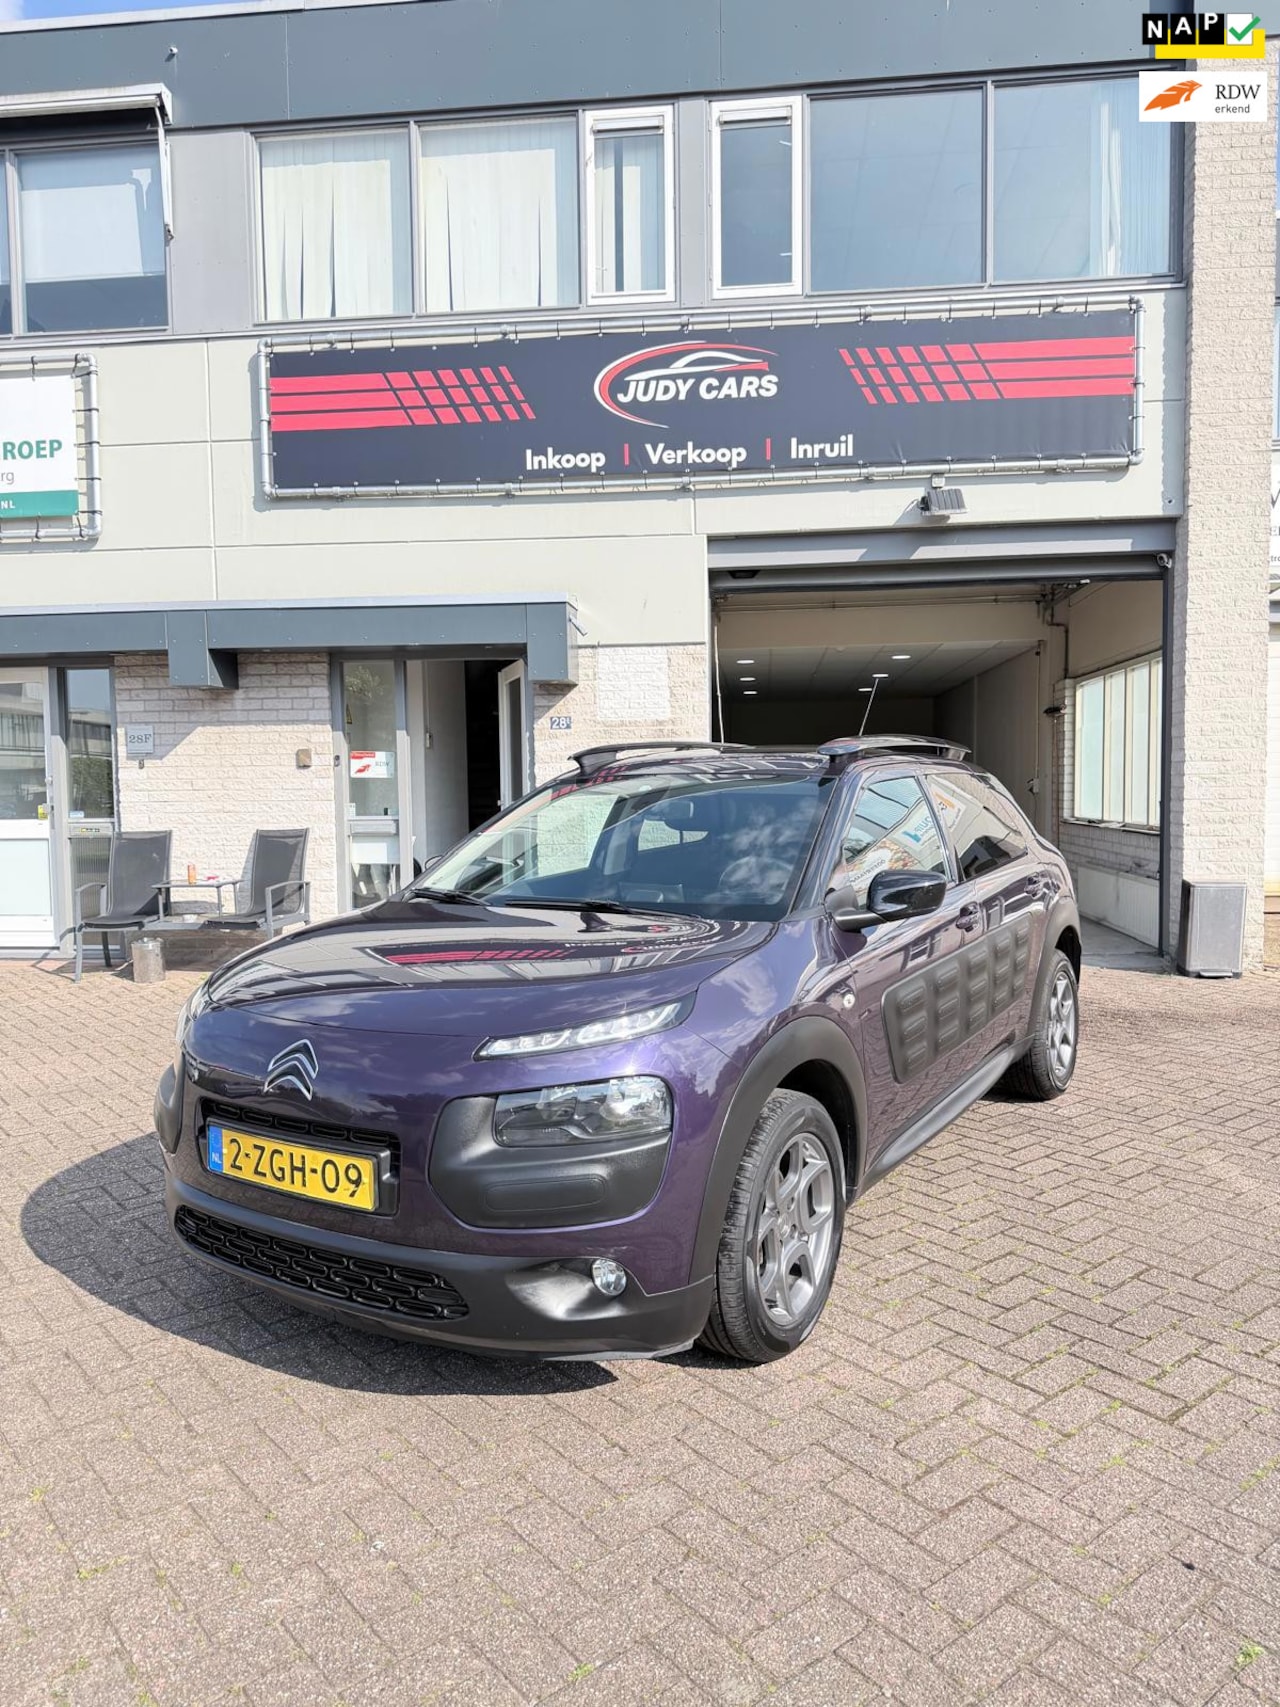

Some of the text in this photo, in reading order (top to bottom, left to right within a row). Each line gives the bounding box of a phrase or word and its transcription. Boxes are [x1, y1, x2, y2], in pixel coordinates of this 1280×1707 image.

[617, 375, 779, 403] JUDY CARS
[526, 434, 854, 473] Inkoop Verkoop Inruil
[128, 733, 152, 744] 28F
[211, 1151, 222, 1164] NL
[229, 1138, 363, 1198] 2-ZGH-09
